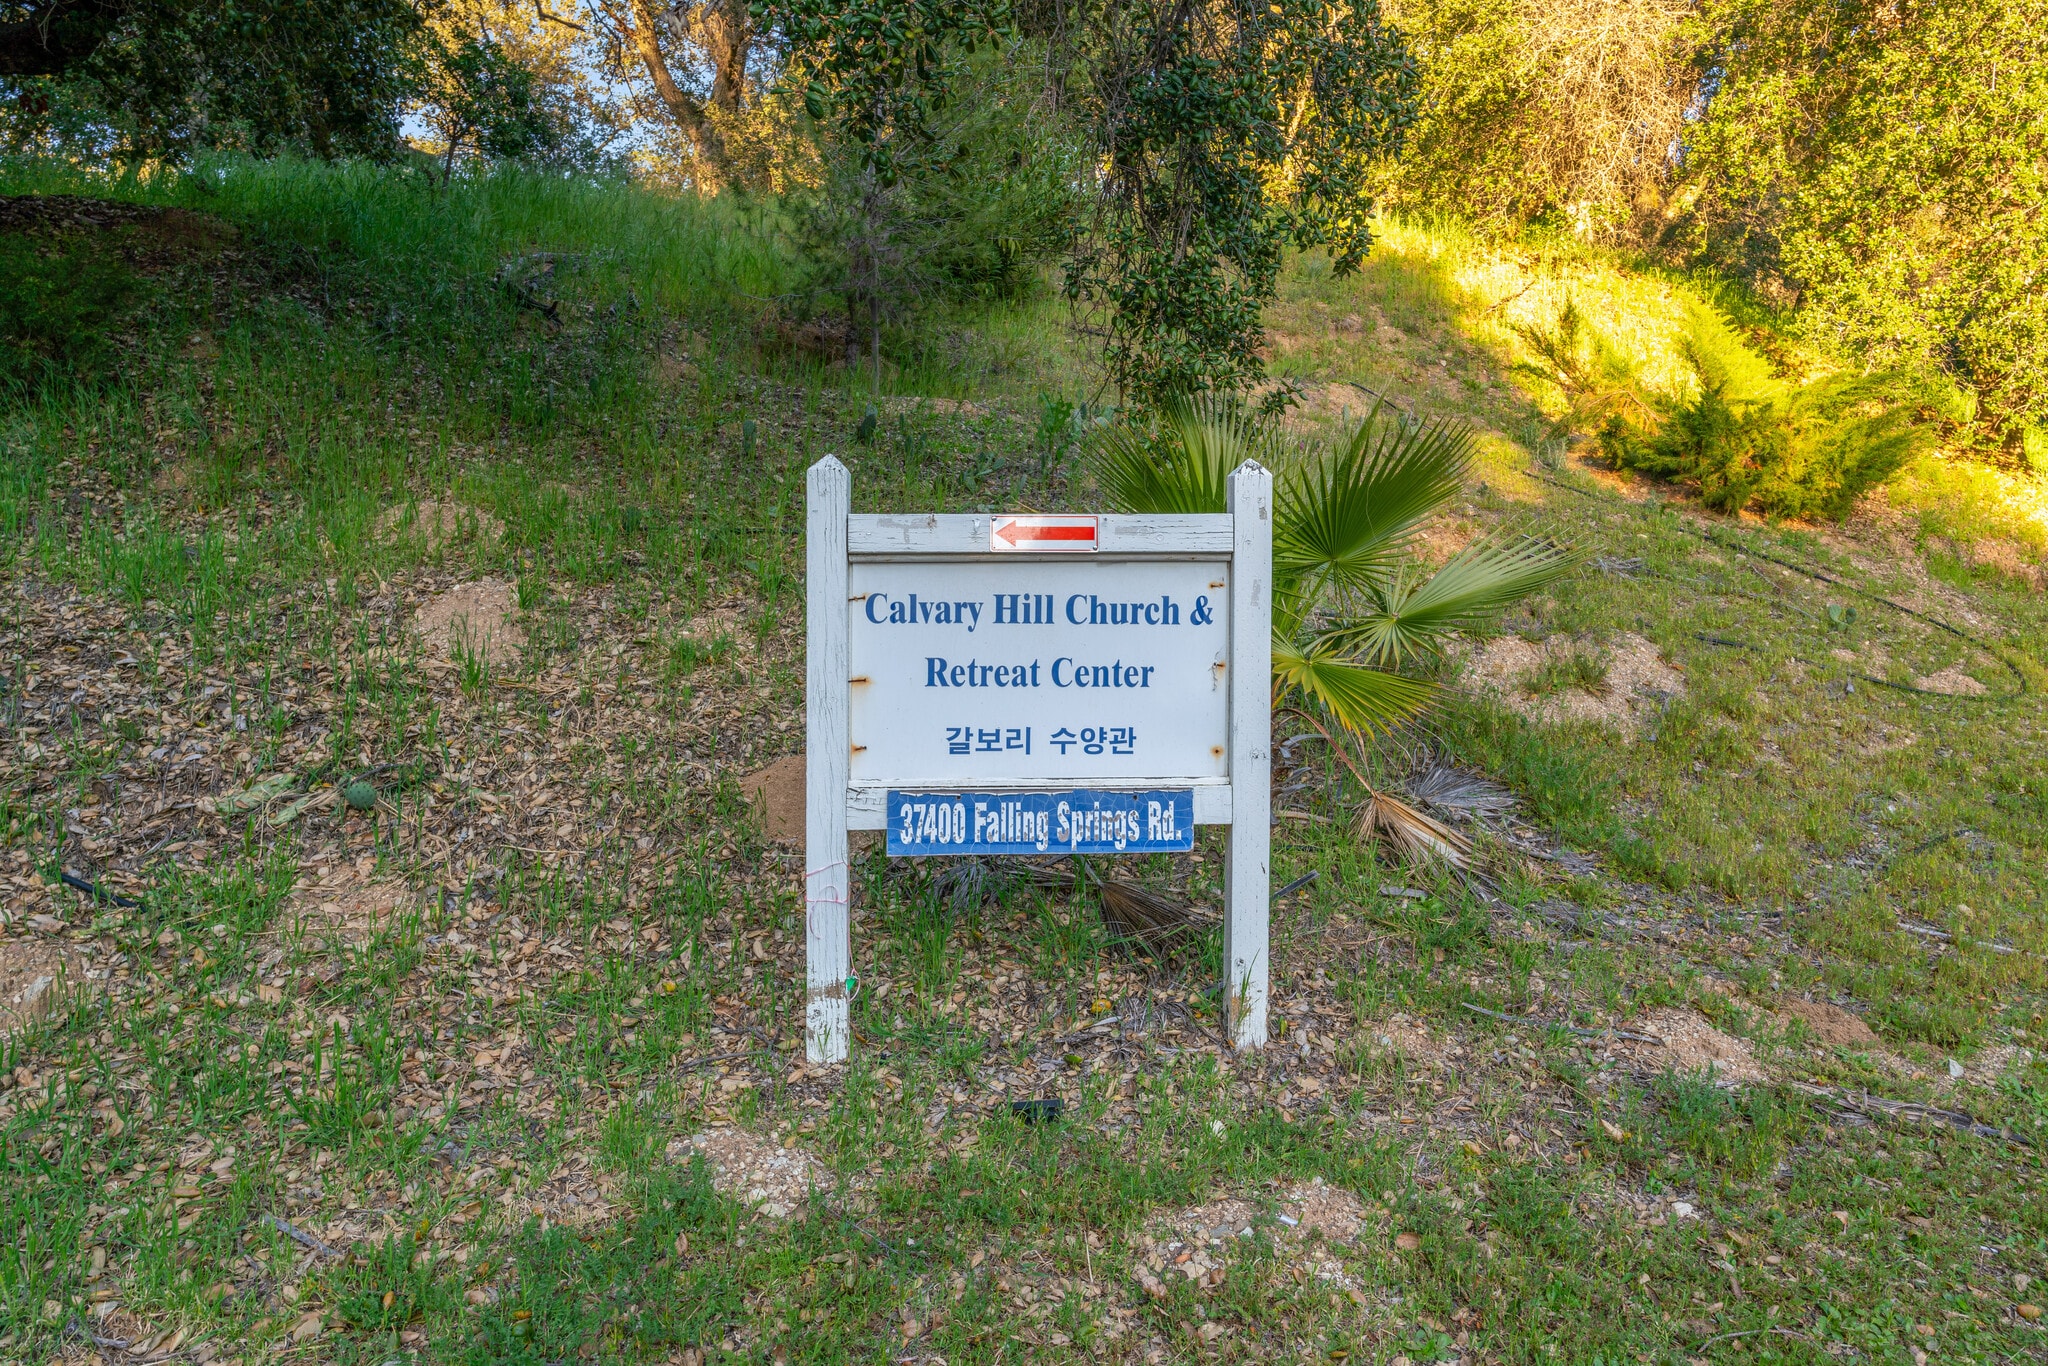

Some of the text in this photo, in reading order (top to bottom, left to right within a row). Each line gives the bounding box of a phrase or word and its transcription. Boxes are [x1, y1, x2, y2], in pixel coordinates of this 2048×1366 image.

[865, 592, 1214, 632] Calvary Hill Church &
[925, 657, 1155, 688] Retreat Center
[945, 726, 1137, 755] 갈보리 수양관
[899, 800, 1182, 851] 37400 Falling Springs Rd.
